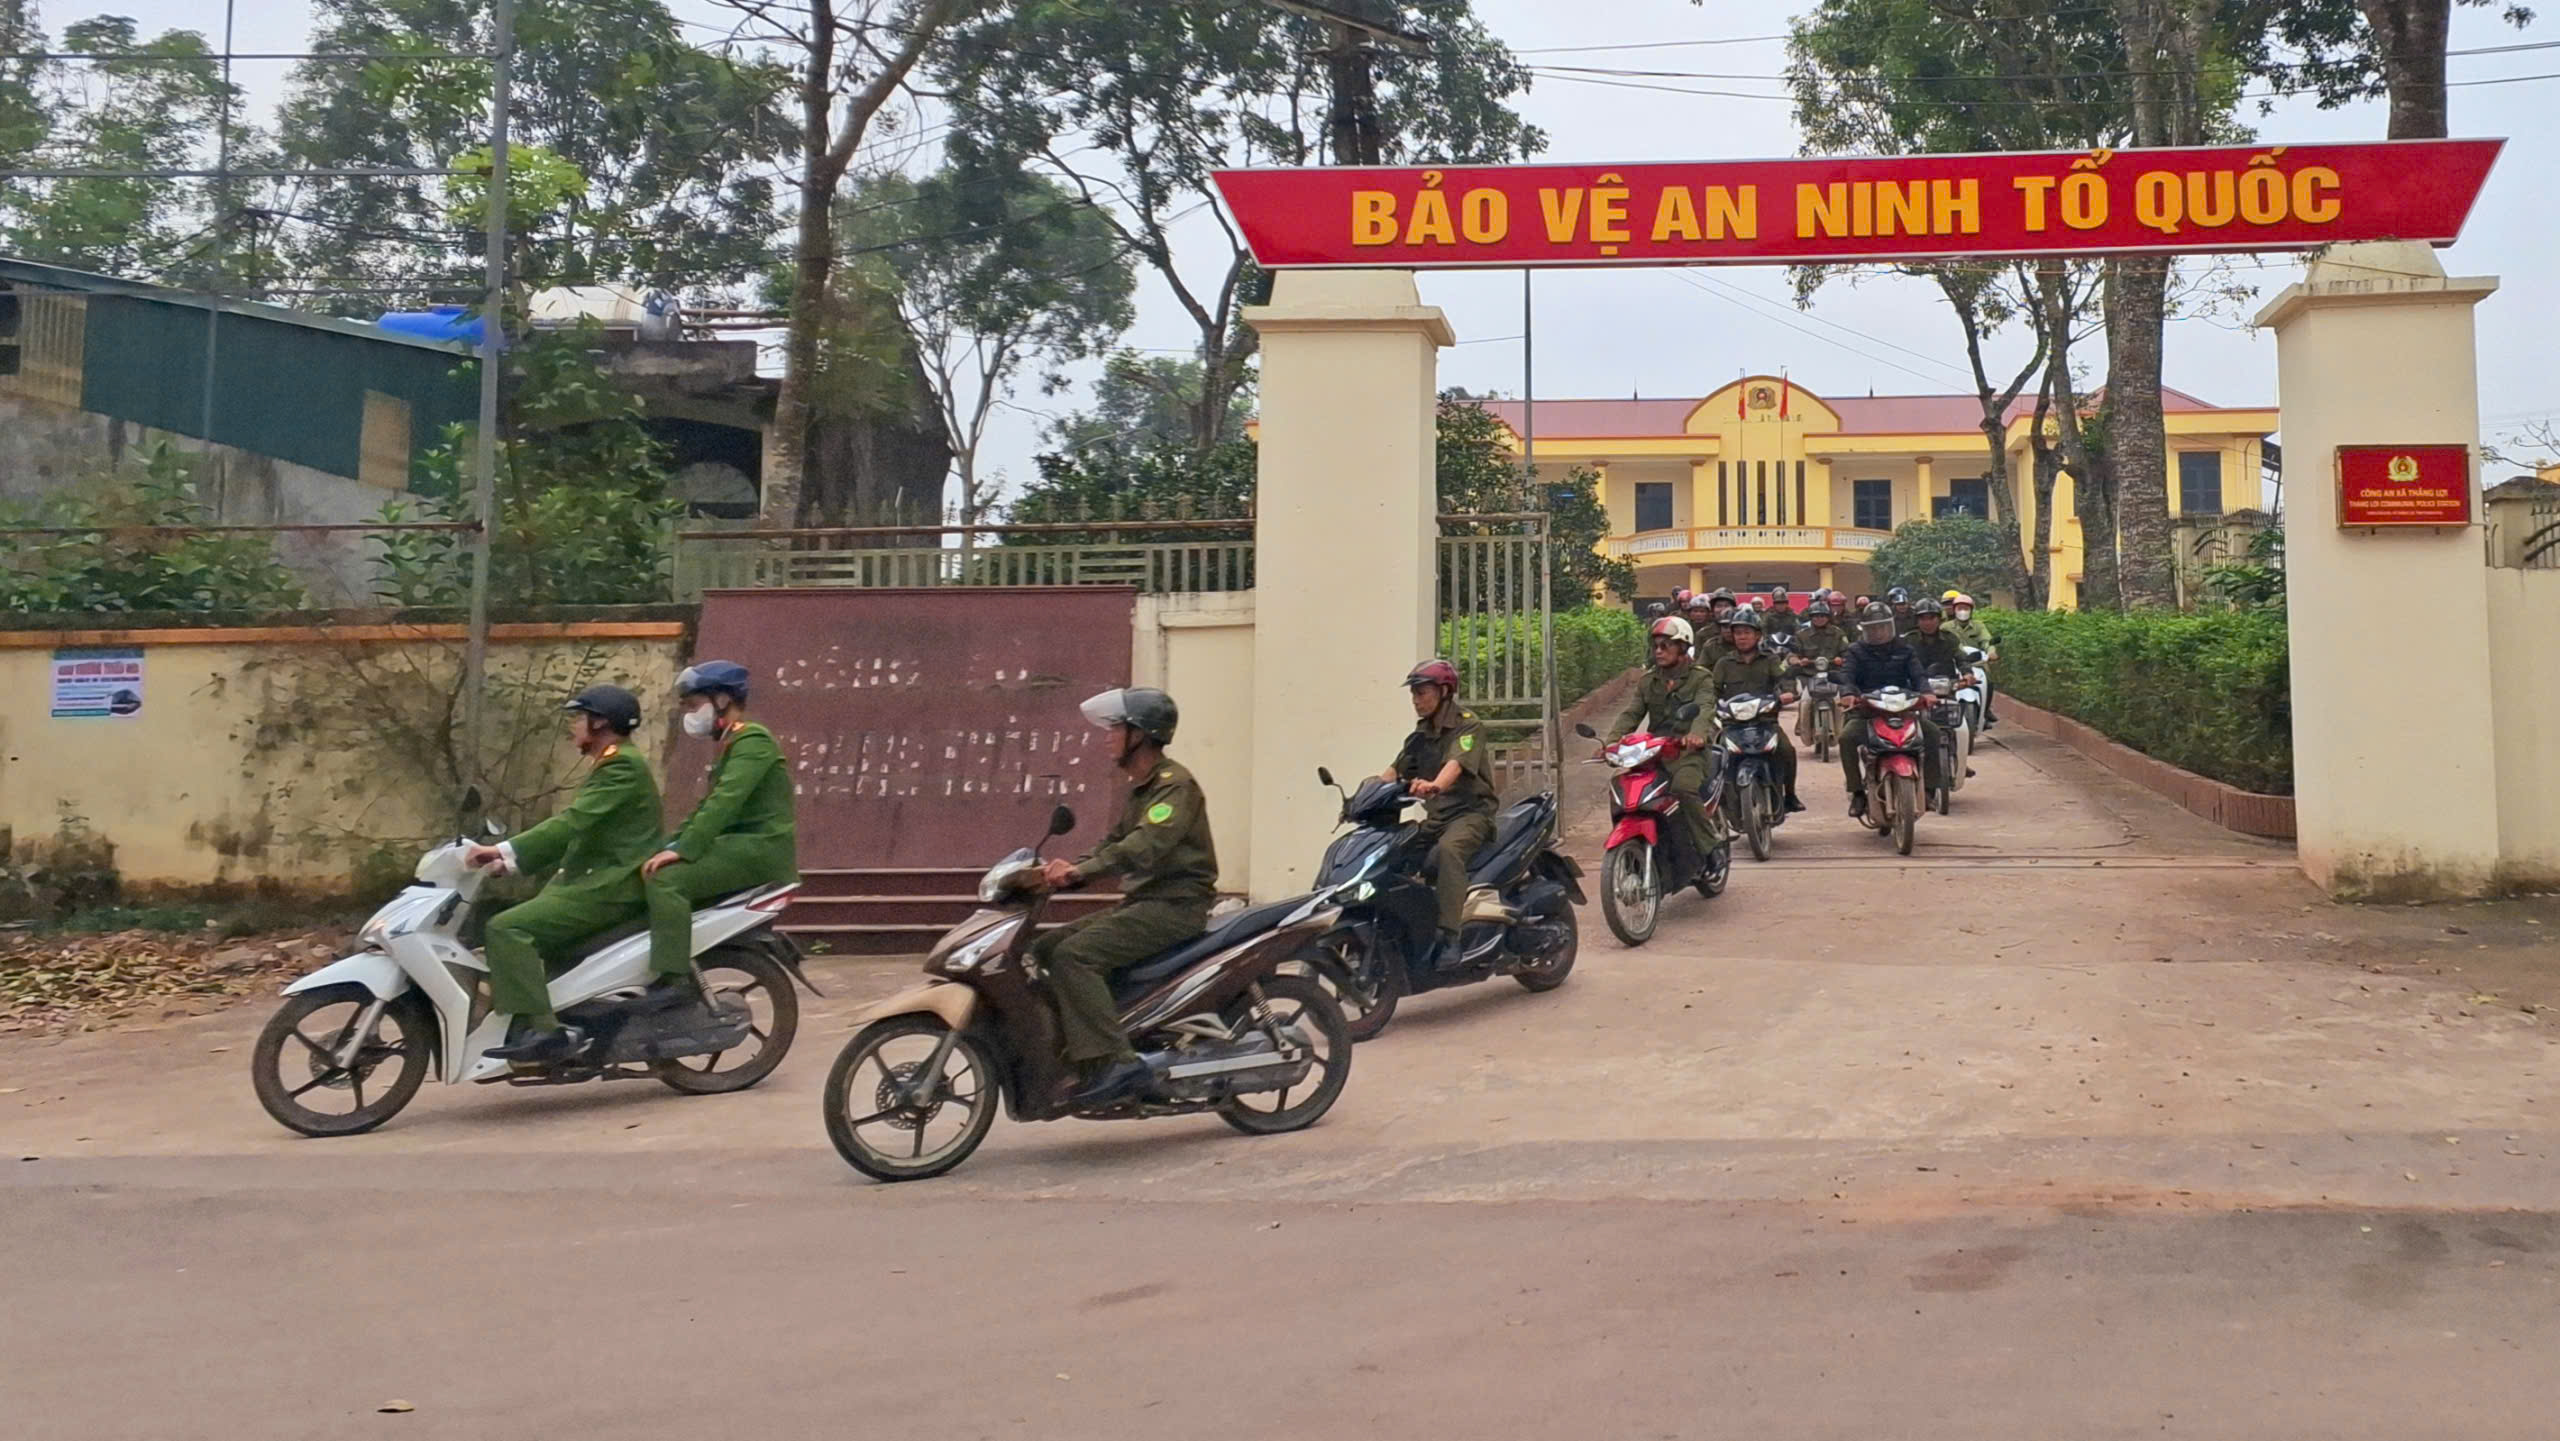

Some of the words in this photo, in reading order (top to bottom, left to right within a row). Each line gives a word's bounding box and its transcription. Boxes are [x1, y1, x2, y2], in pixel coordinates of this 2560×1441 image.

[1351, 171, 1510, 246] BẢO
[1539, 173, 1631, 256] VỆ
[1651, 183, 1758, 242] AN
[1796, 179, 1981, 239] NINH
[2014, 147, 2114, 232] TỔ
[2135, 147, 2342, 234] QUỐC
[2383, 489, 2395, 497] AN
